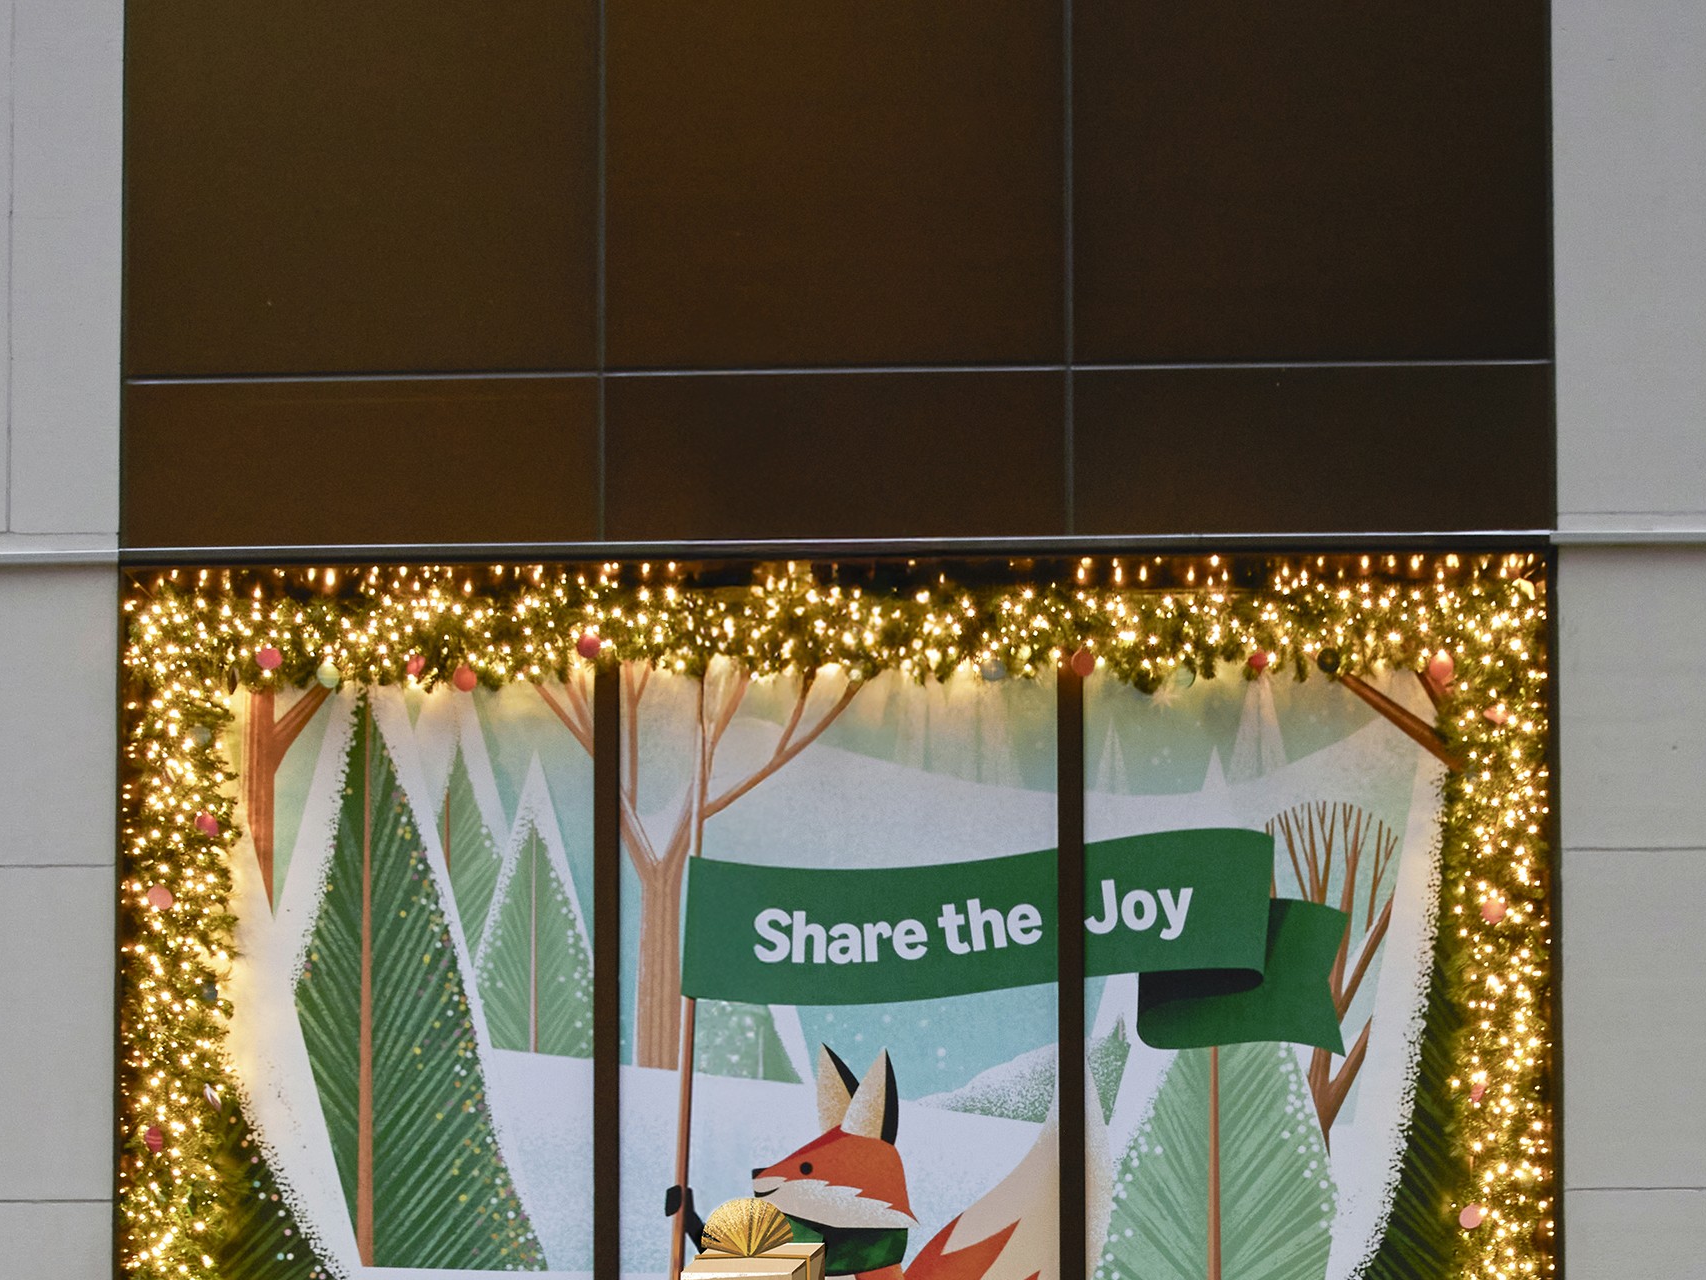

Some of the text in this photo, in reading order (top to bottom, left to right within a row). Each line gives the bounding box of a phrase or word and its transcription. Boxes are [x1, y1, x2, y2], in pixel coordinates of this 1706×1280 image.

[753, 879, 1193, 964] Share the Joy
